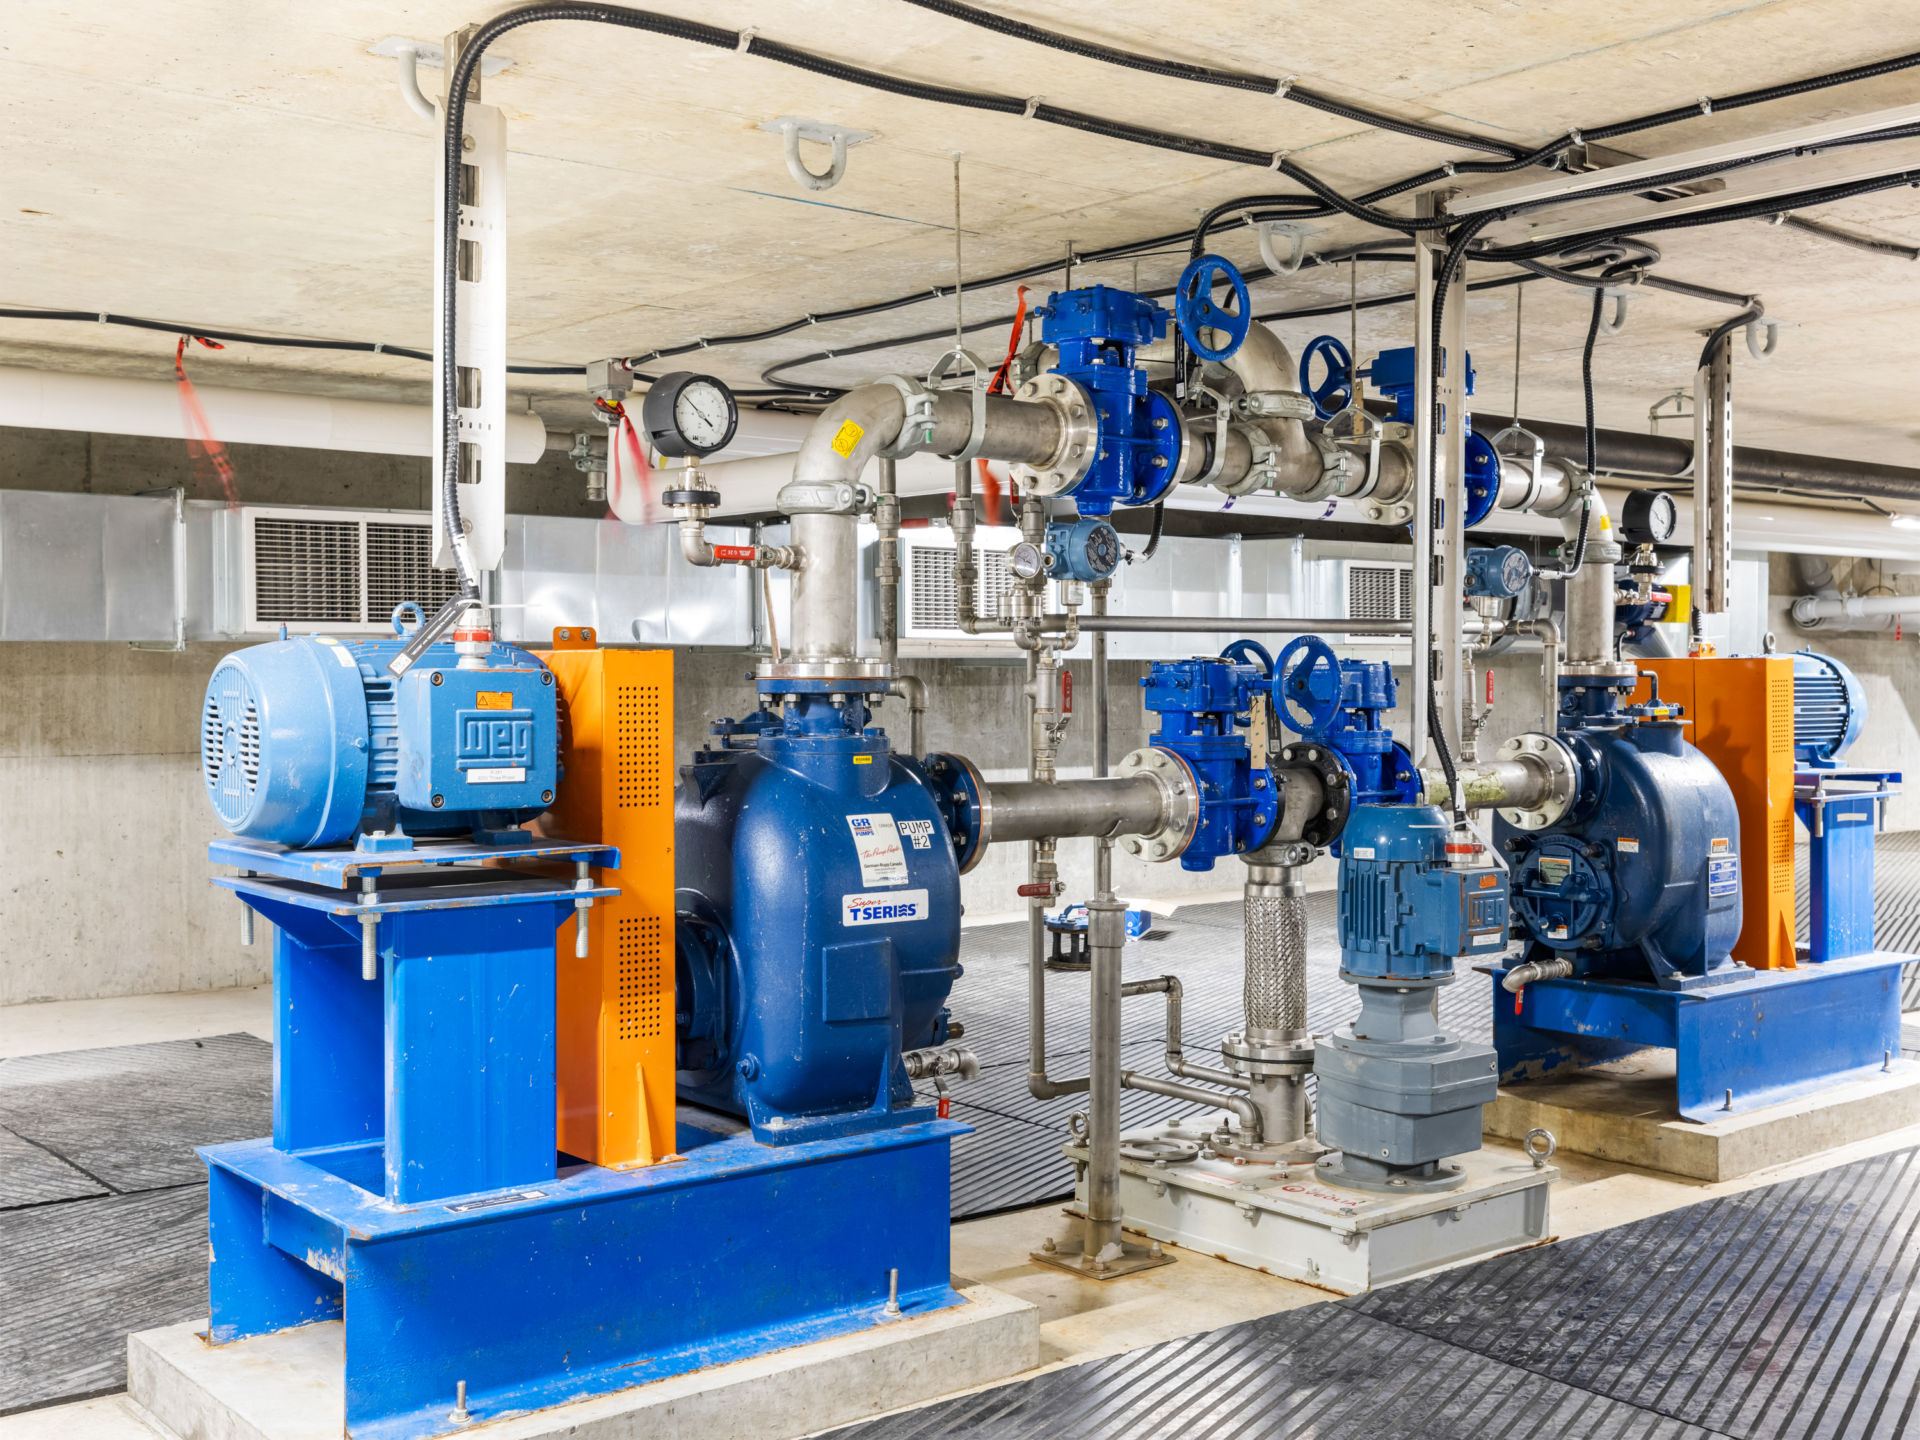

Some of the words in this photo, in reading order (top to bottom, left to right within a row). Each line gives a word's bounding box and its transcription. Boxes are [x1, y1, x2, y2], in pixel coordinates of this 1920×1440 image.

[900, 821, 931, 834] PUMP
[913, 835, 929, 848] #2
[863, 903, 917, 920] SERIES
[1305, 1190, 1357, 1206] VEOLIA
